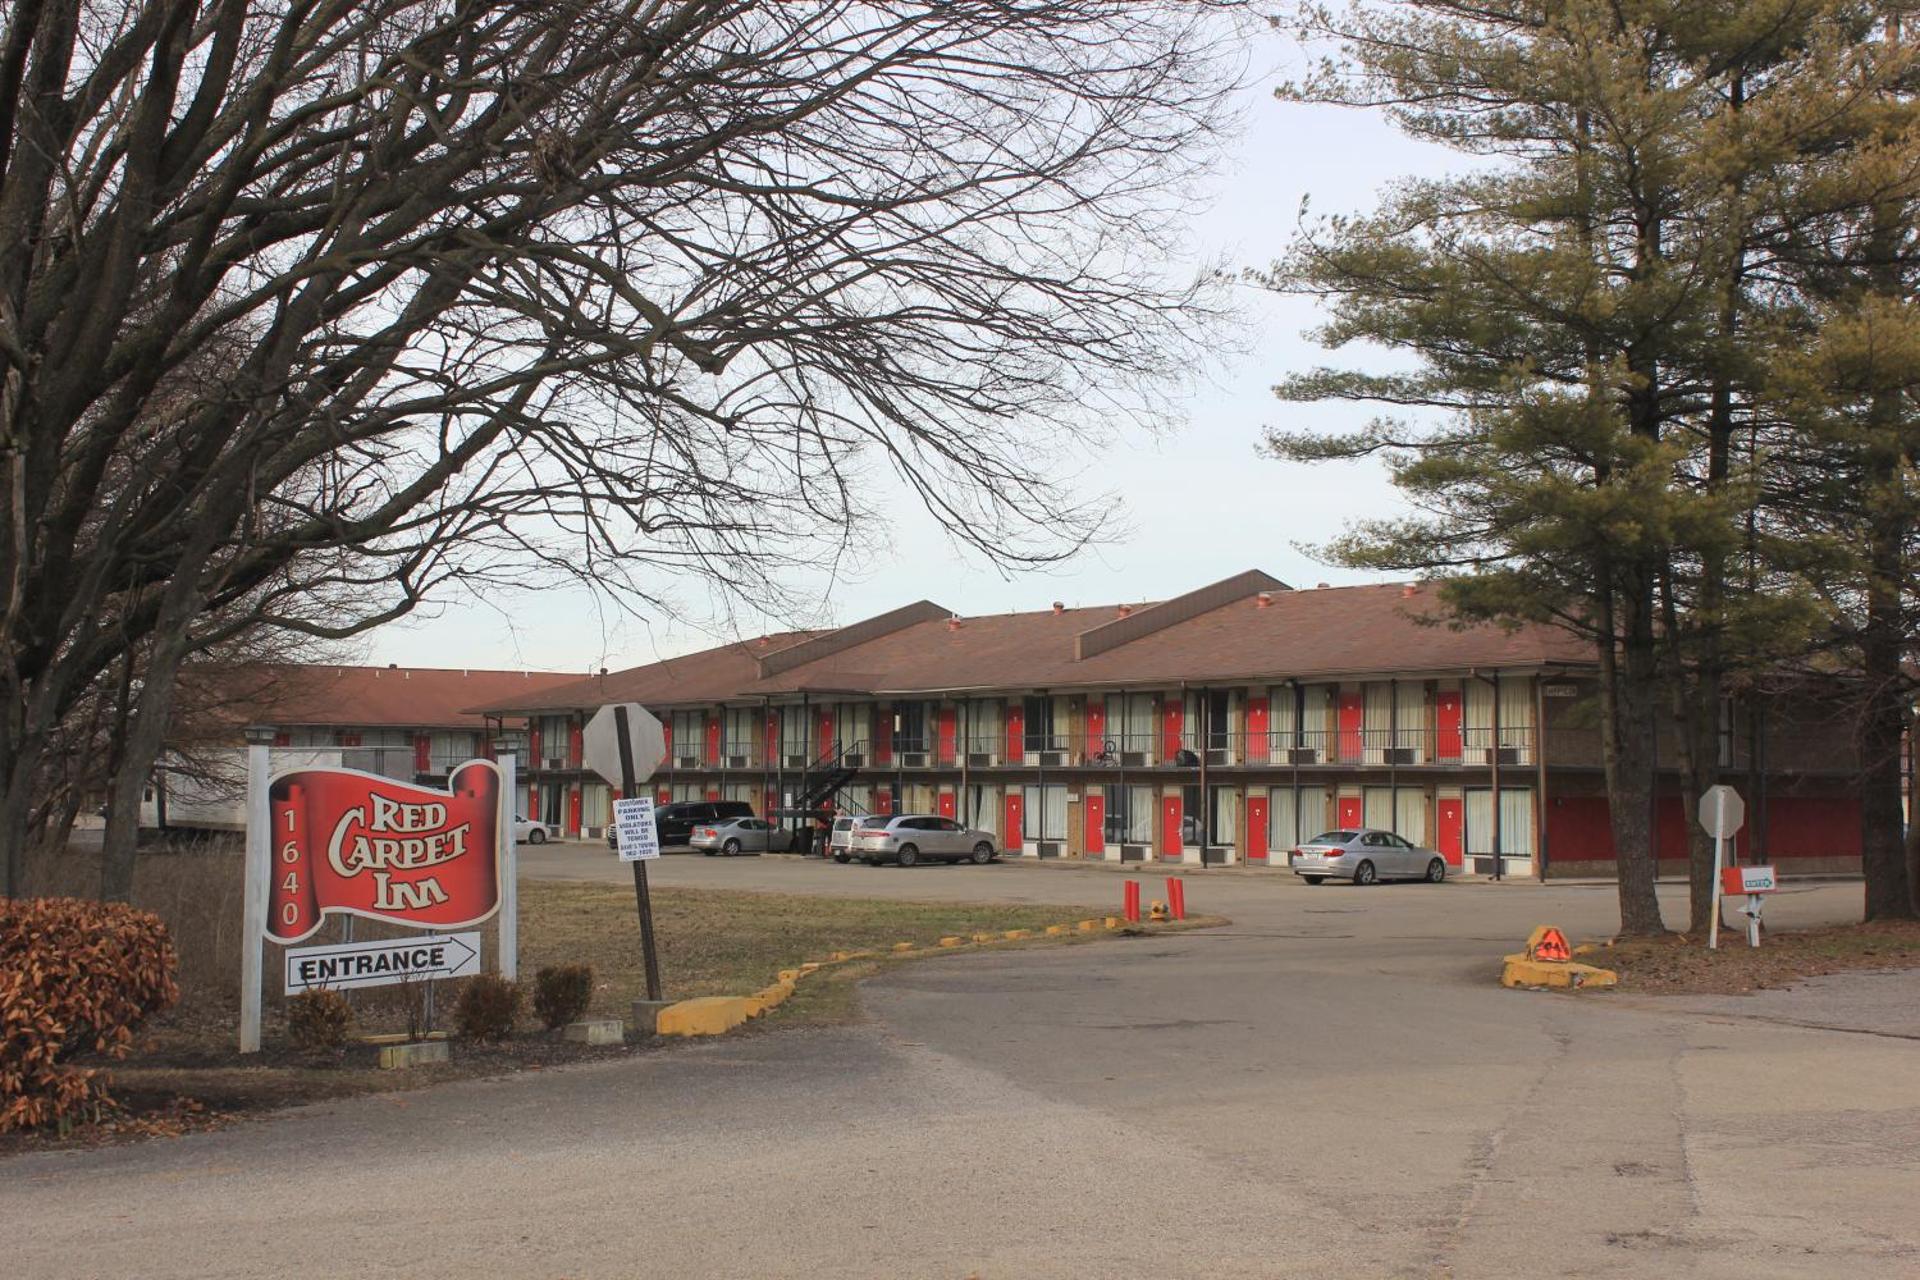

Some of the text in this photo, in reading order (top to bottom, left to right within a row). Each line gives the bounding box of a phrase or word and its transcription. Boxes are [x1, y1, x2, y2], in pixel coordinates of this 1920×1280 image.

[370, 792, 447, 833] RED
[618, 806, 651, 814] PARKING
[328, 806, 470, 878] CARPET
[624, 828, 640, 836] WILL
[627, 834, 649, 842] TOWED
[282, 809, 299, 926] 1640
[300, 948, 444, 981] ENTRANCE
